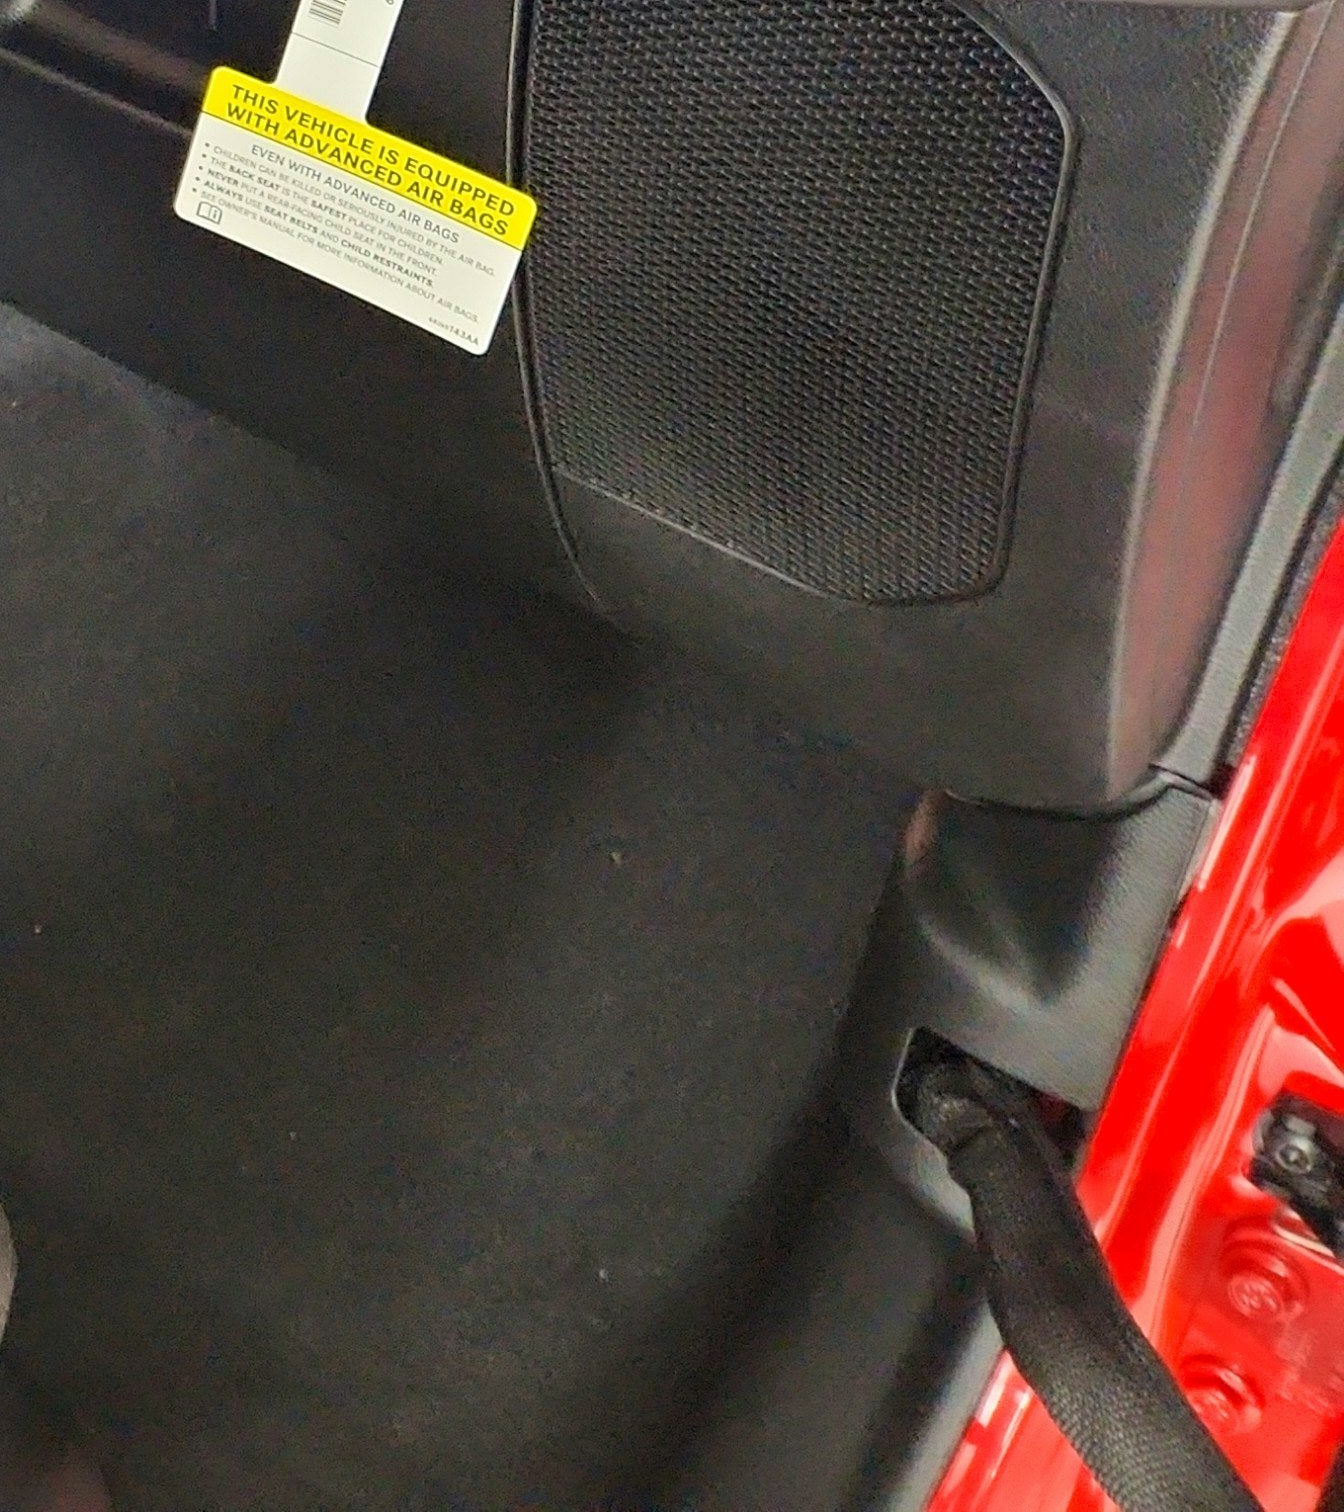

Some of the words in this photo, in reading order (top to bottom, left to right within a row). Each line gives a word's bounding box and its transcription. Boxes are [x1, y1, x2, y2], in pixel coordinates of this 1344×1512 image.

[223, 102, 280, 136] WITH
[283, 127, 403, 188] ADVANCED
[406, 179, 445, 206] AIR
[448, 199, 509, 236] BAGS
[228, 83, 279, 115] THIS
[281, 105, 375, 155] VEHICLE
[377, 145, 400, 165] IS
[402, 157, 517, 217] EQUIPPED
[250, 144, 285, 166] EVEN
[286, 160, 322, 181] WITH
[322, 175, 396, 214] ADVANCED
[397, 208, 422, 225] AIR
[423, 220, 461, 243] BAGS
